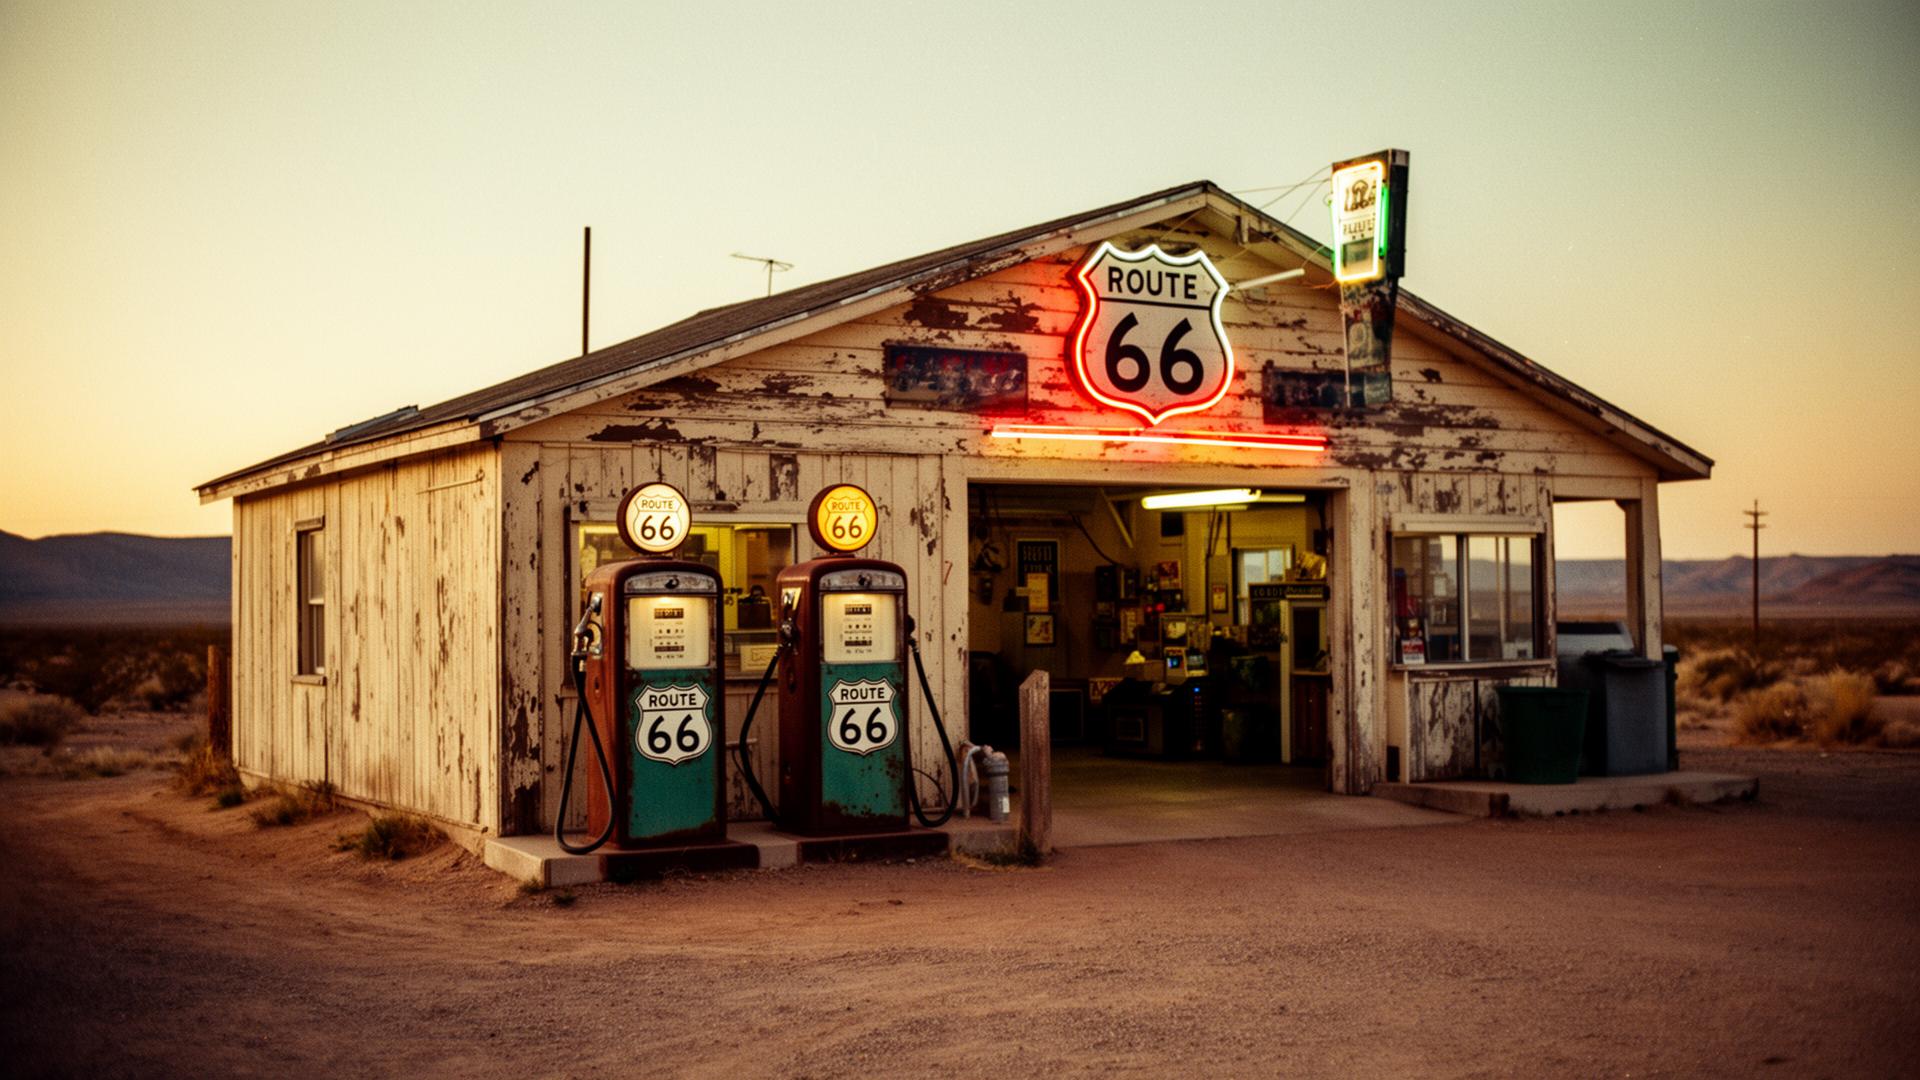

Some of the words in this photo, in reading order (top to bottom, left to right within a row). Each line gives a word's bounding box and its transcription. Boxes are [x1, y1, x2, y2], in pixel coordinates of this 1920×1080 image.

[1108, 266, 1197, 300] ROUTE
[1105, 312, 1204, 395] 66
[641, 499, 673, 509] ROUTE
[832, 501, 860, 510] ROUTE
[641, 515, 674, 540] 66
[832, 515, 862, 539] 66
[648, 693, 697, 707] ROUTE
[840, 687, 885, 700] ROUTE
[648, 714, 699, 754] 66
[840, 707, 887, 745] 66
